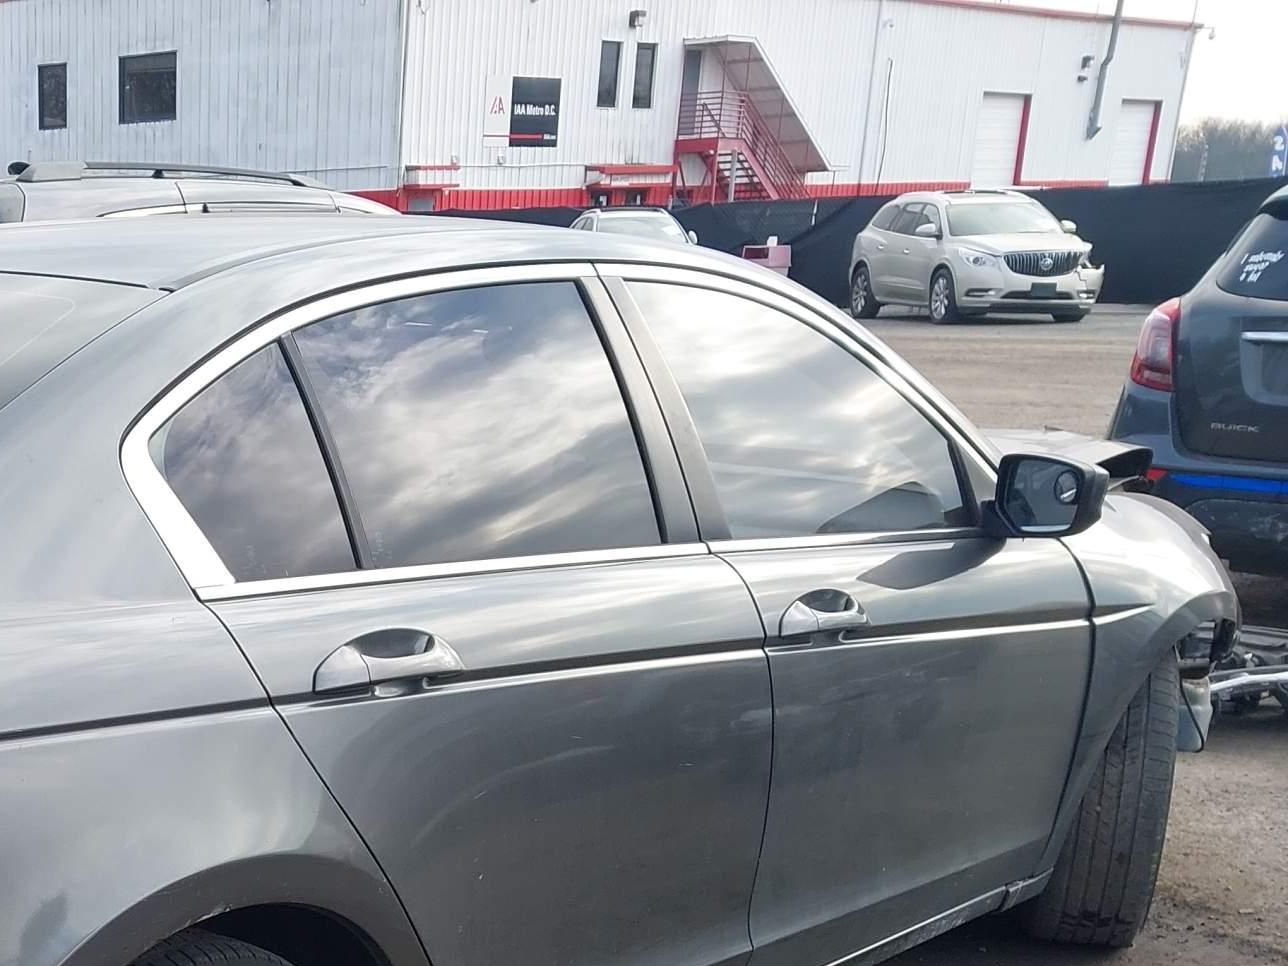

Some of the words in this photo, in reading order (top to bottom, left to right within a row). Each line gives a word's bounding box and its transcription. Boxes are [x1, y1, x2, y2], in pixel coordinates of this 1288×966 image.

[514, 103, 526, 116] IAA
[526, 103, 544, 116] Metro
[1210, 422, 1260, 433] BUICK
